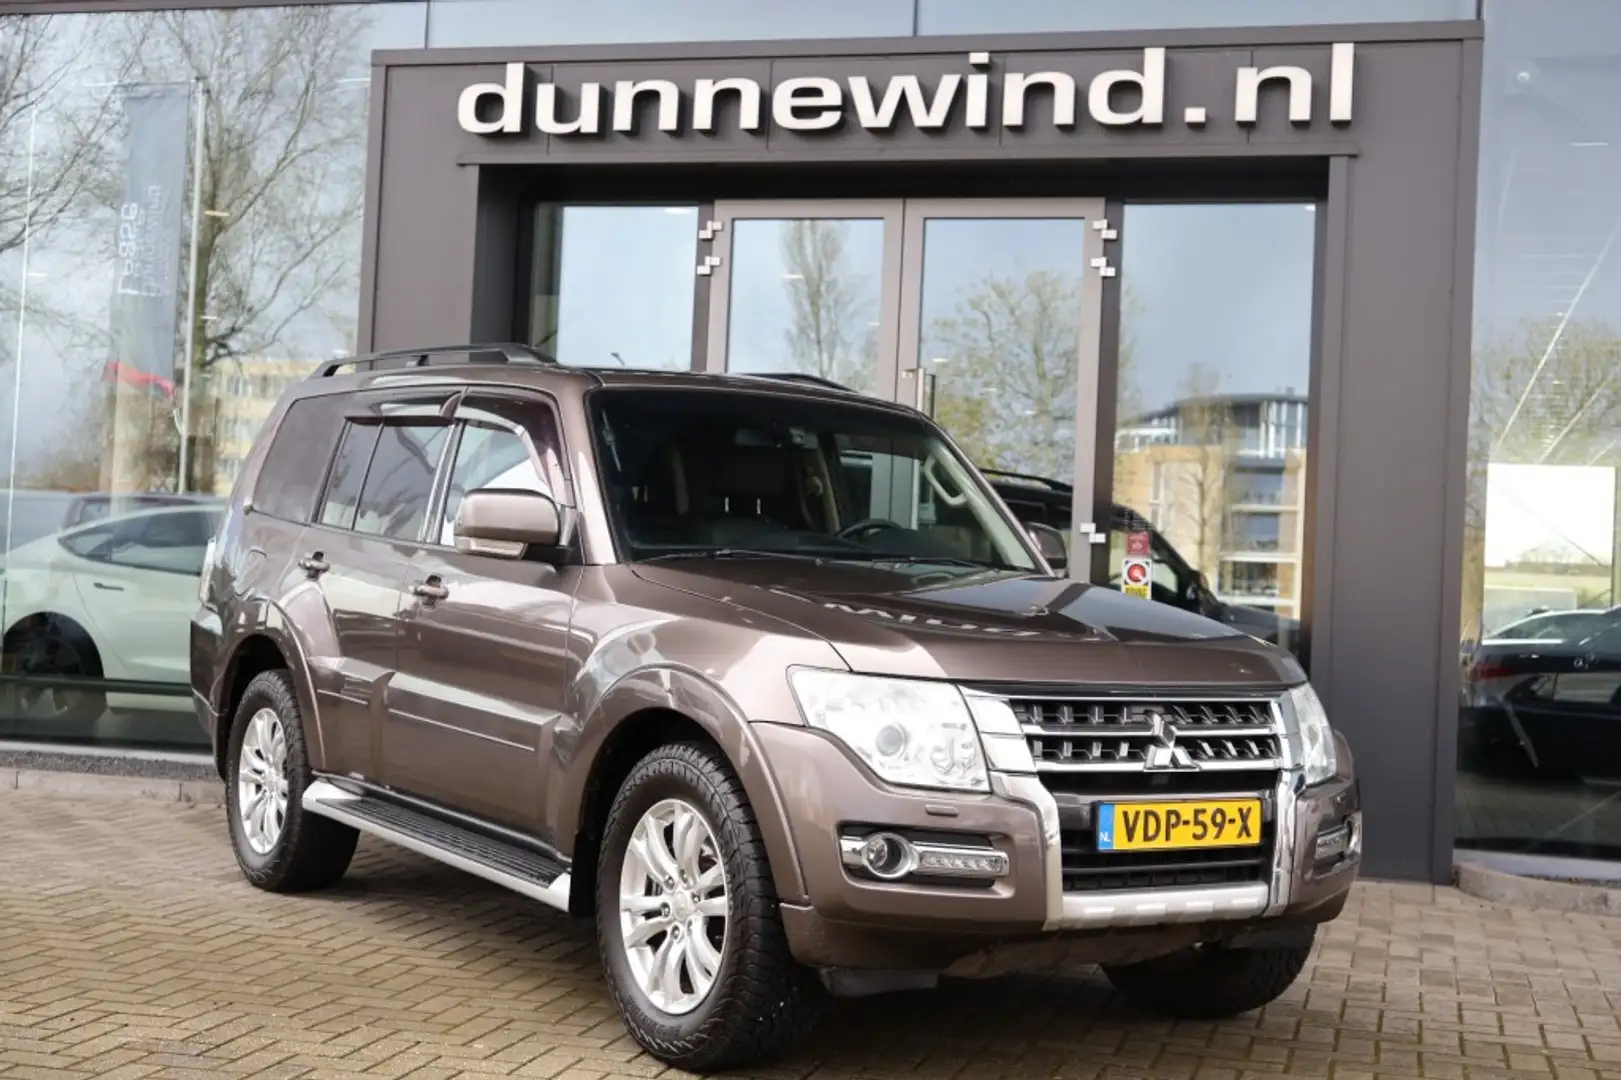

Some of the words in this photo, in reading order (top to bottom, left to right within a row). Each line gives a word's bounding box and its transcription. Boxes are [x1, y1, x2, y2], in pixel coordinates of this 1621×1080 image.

[457, 42, 1355, 134] dunnewind.nl
[1100, 832, 1111, 842] NL
[1122, 807, 1252, 842] VDP-59-X
